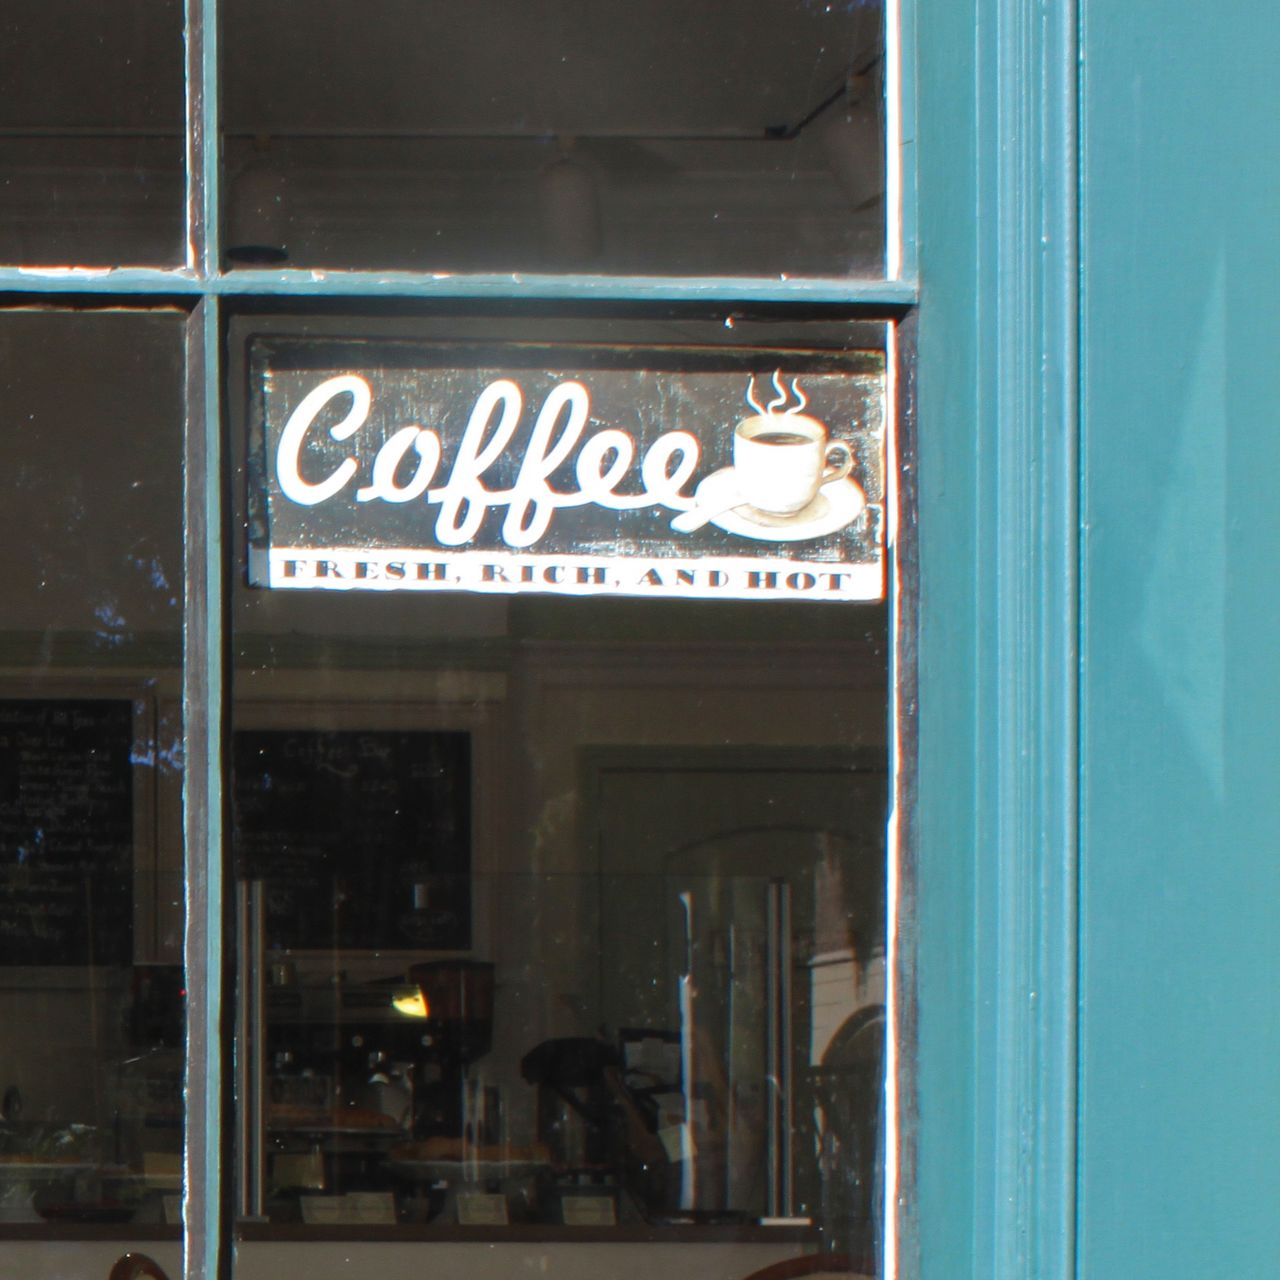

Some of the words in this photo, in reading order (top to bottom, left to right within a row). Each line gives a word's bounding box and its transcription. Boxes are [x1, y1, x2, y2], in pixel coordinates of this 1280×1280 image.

[276, 374, 700, 549] Coffee
[280, 559, 462, 584] FRESH,
[481, 563, 622, 588] RICH,
[639, 567, 729, 588] AND
[746, 570, 852, 591] HOT
